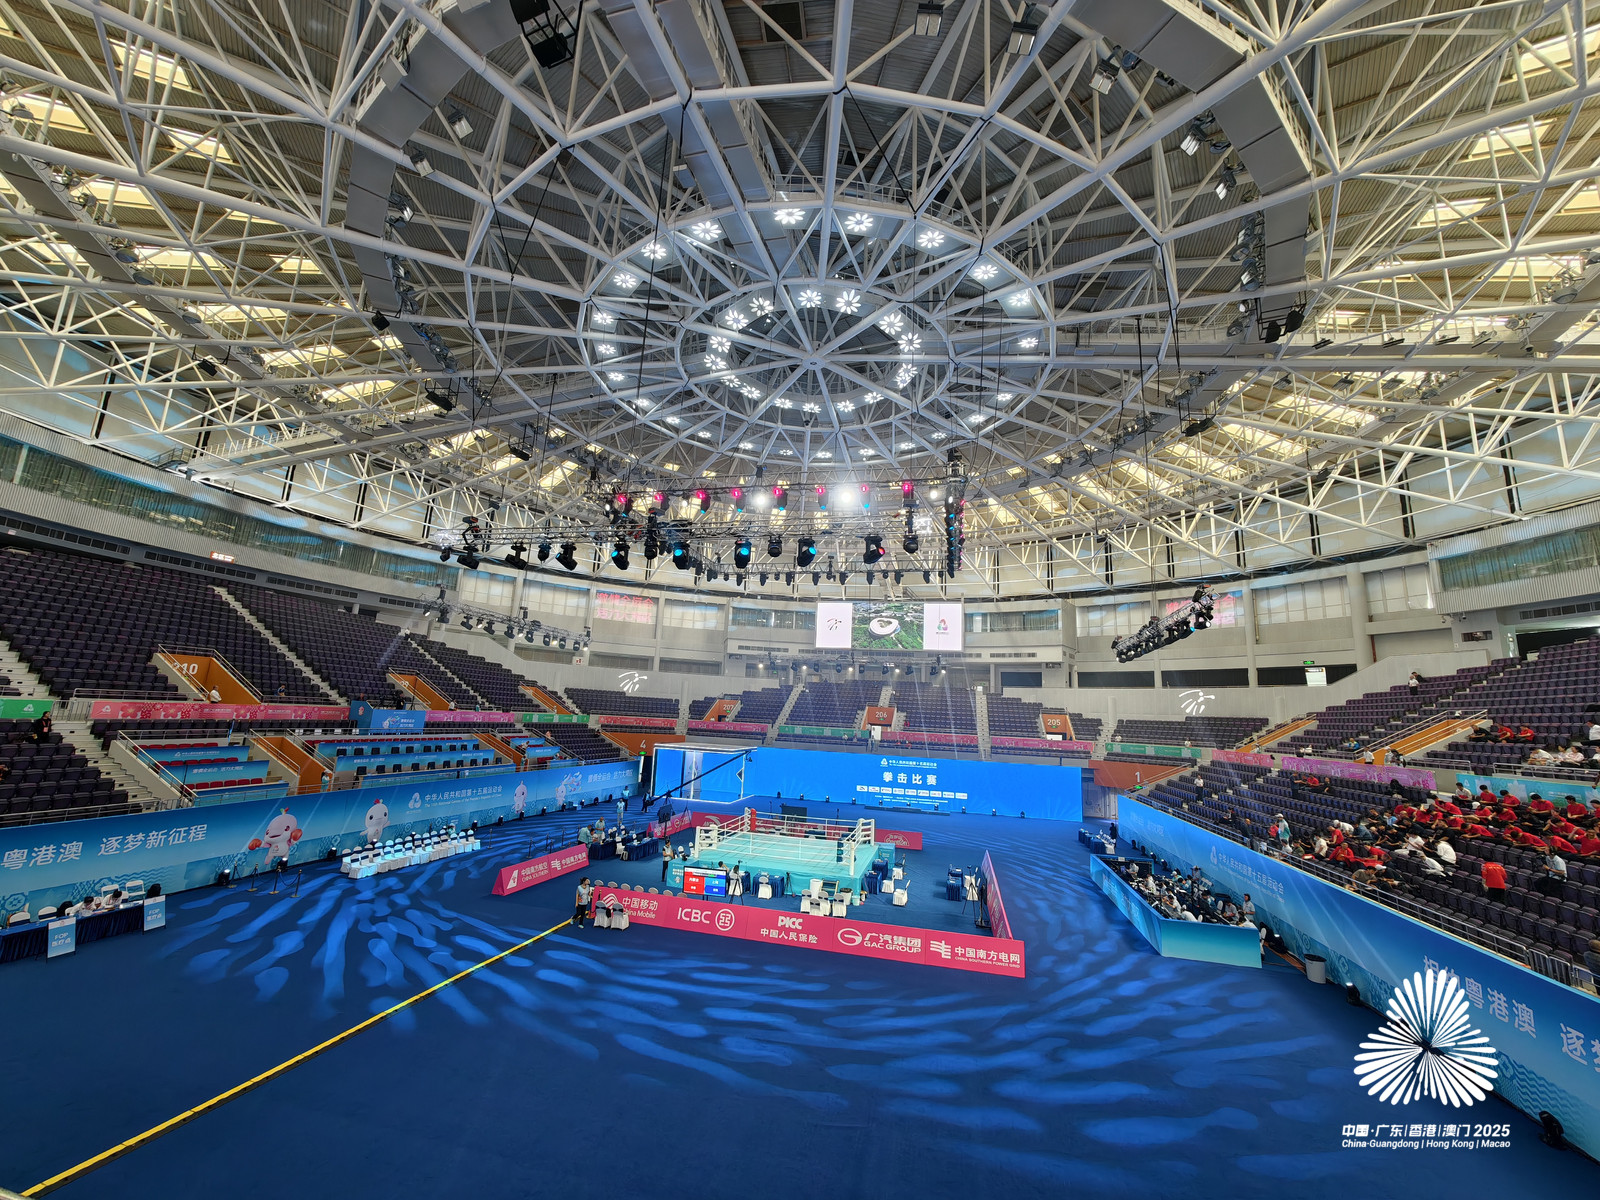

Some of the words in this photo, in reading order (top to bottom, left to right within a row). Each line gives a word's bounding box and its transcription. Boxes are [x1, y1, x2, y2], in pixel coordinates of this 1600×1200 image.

[1047, 718, 1061, 726] 205
[640, 740, 646, 748] 4
[883, 771, 937, 786] 拳击比赛
[1135, 771, 1140, 783] 1
[98, 824, 208, 857] 逐梦新征程
[1, 840, 83, 870] 粤港澳
[622, 897, 658, 911] 中国移动
[639, 910, 656, 919] Mobile
[677, 907, 712, 924] ICBC
[778, 915, 803, 930] PICC
[760, 928, 818, 943] 中国人民保险
[864, 932, 921, 947] 广汽集团
[863, 940, 885, 949] GAC
[885, 943, 922, 953] GROUP
[955, 946, 1020, 964] 中国南方电网
